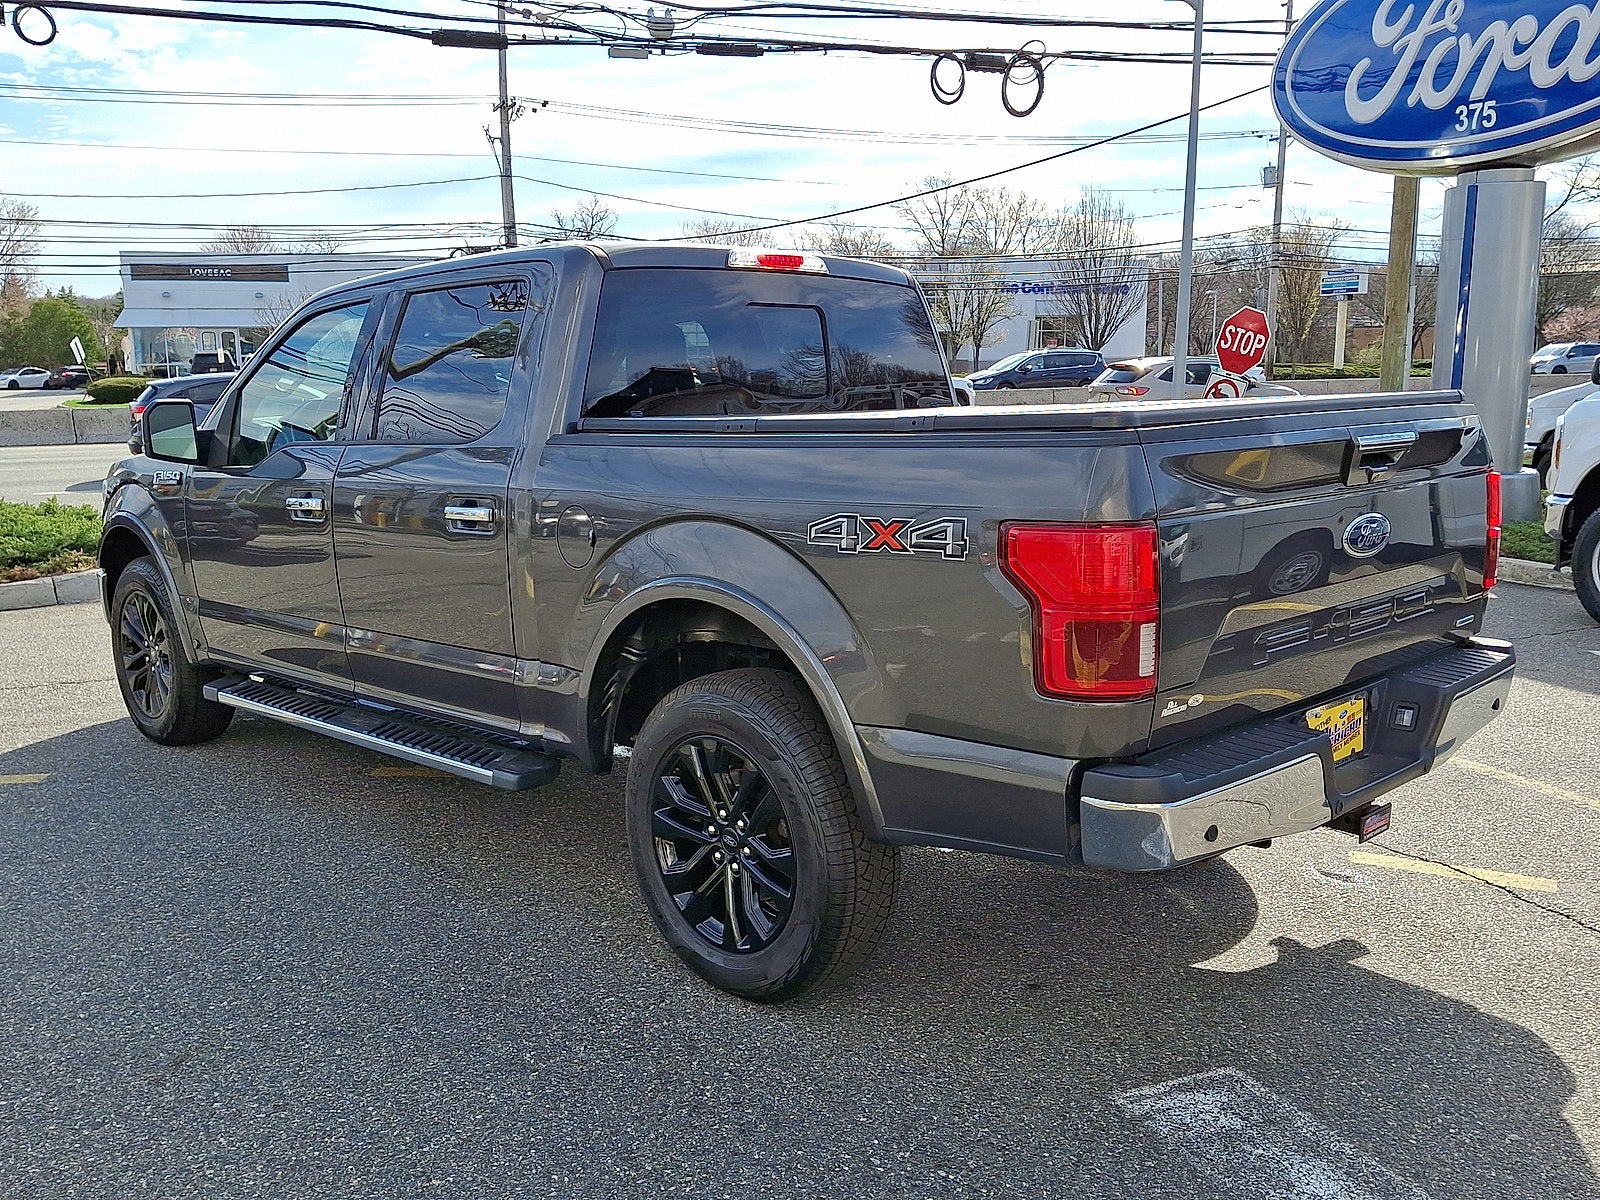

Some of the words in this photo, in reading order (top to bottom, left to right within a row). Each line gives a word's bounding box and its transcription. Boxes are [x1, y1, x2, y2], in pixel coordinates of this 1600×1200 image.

[1344, 0, 1600, 124] Ford
[1454, 100, 1498, 132] 375
[189, 268, 232, 277] LOVESAC
[1221, 325, 1266, 357] STOP
[1356, 522, 1391, 548] Ford
[1315, 715, 1332, 731] OTHER
[1330, 716, 1362, 746] ERICAN
